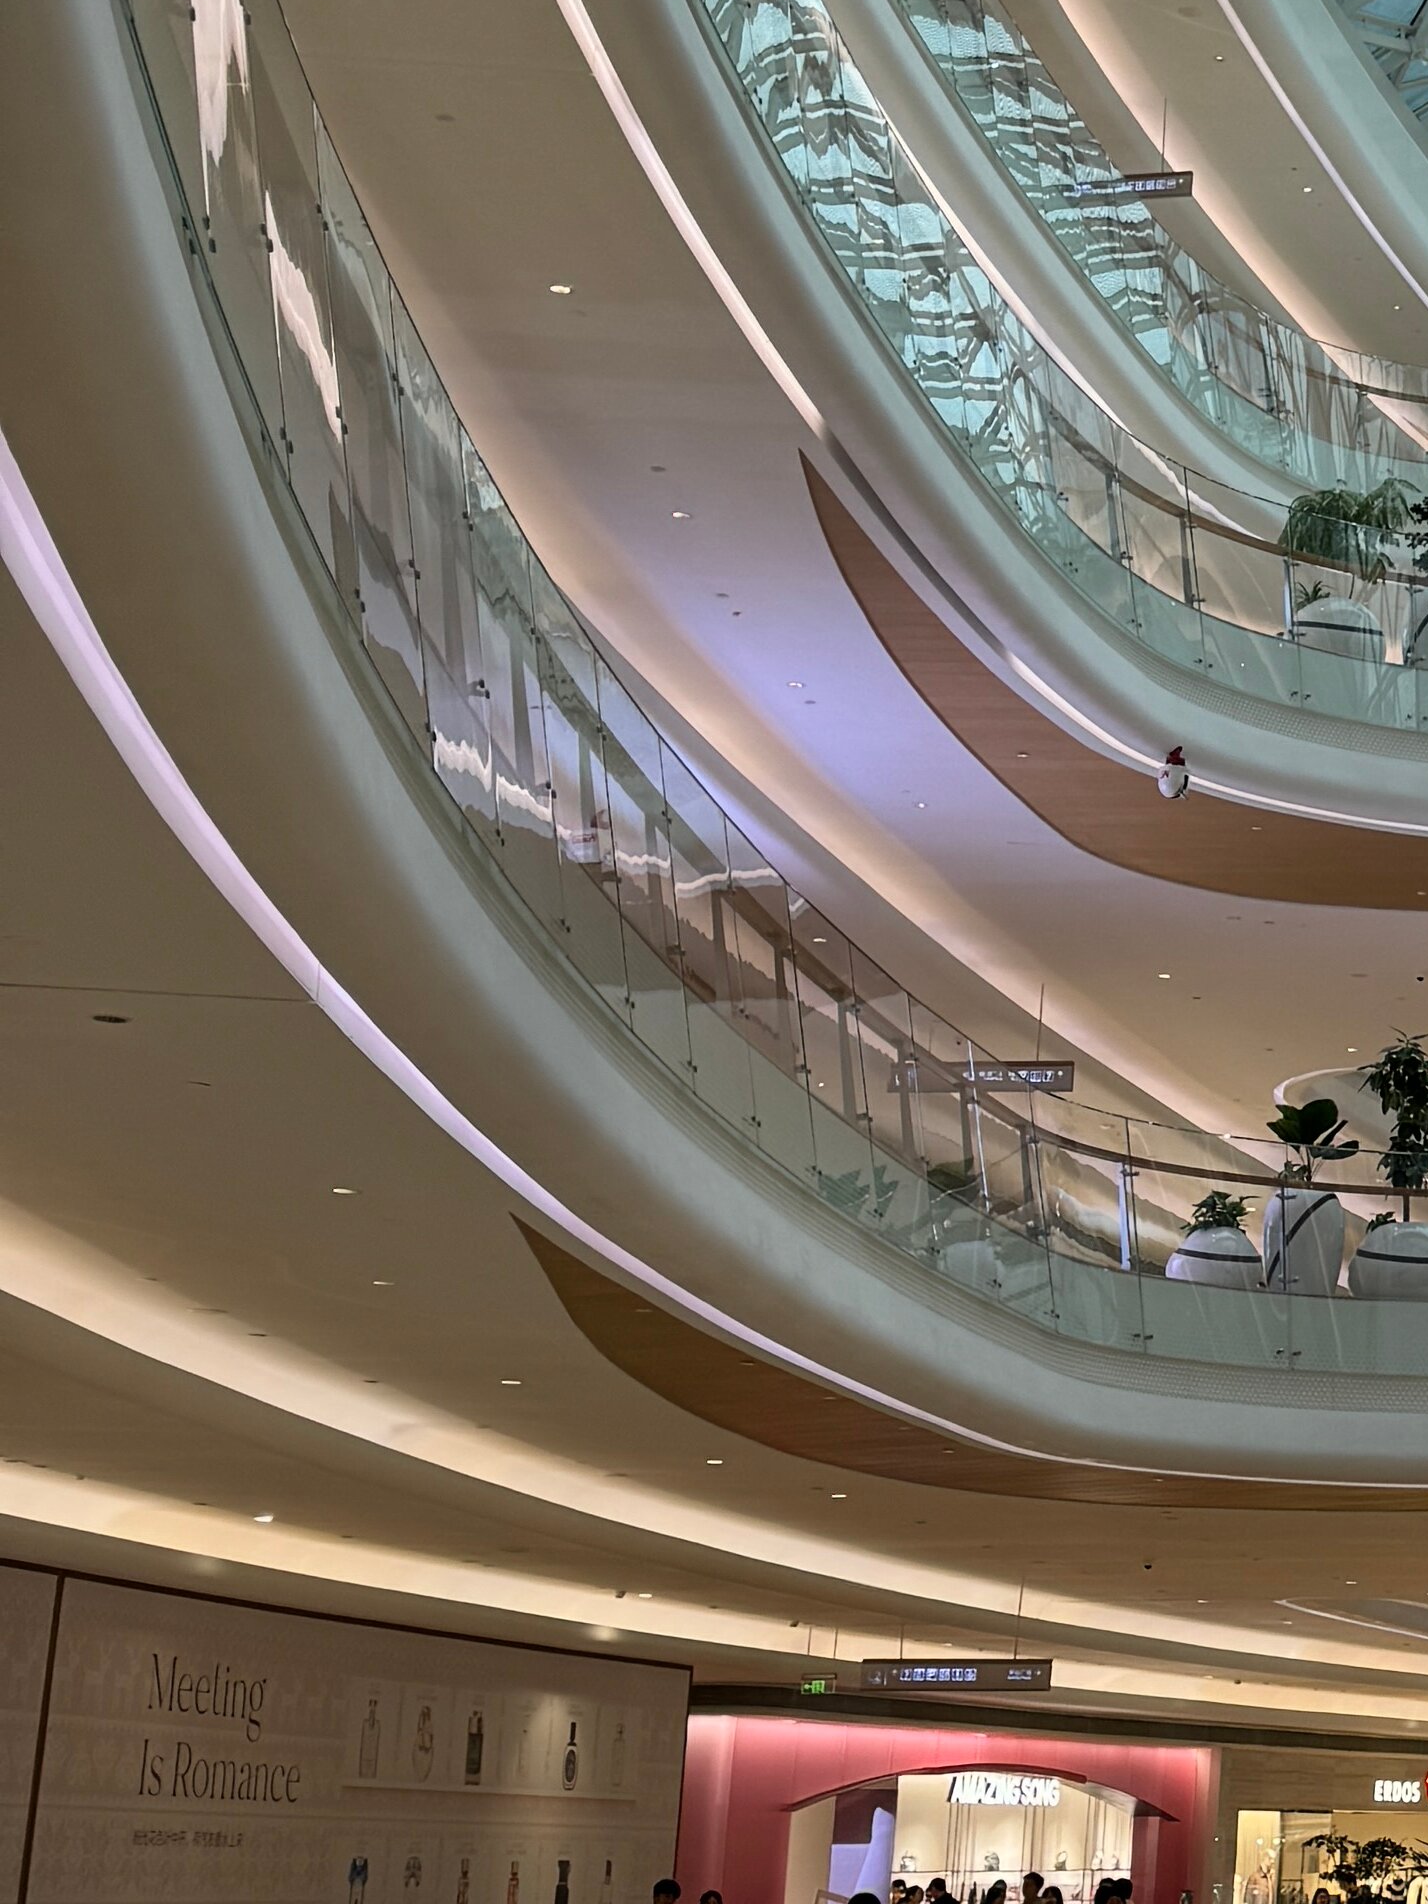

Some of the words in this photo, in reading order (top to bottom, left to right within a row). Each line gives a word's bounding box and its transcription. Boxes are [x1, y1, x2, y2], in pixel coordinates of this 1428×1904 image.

[148, 1653, 268, 1743] Meeting
[138, 1738, 164, 1797] Is
[171, 1741, 302, 1804] Romance
[948, 1774, 1021, 1805] AMAZING
[1020, 1777, 1061, 1807] SONG
[1374, 1779, 1421, 1803] ERDOS
